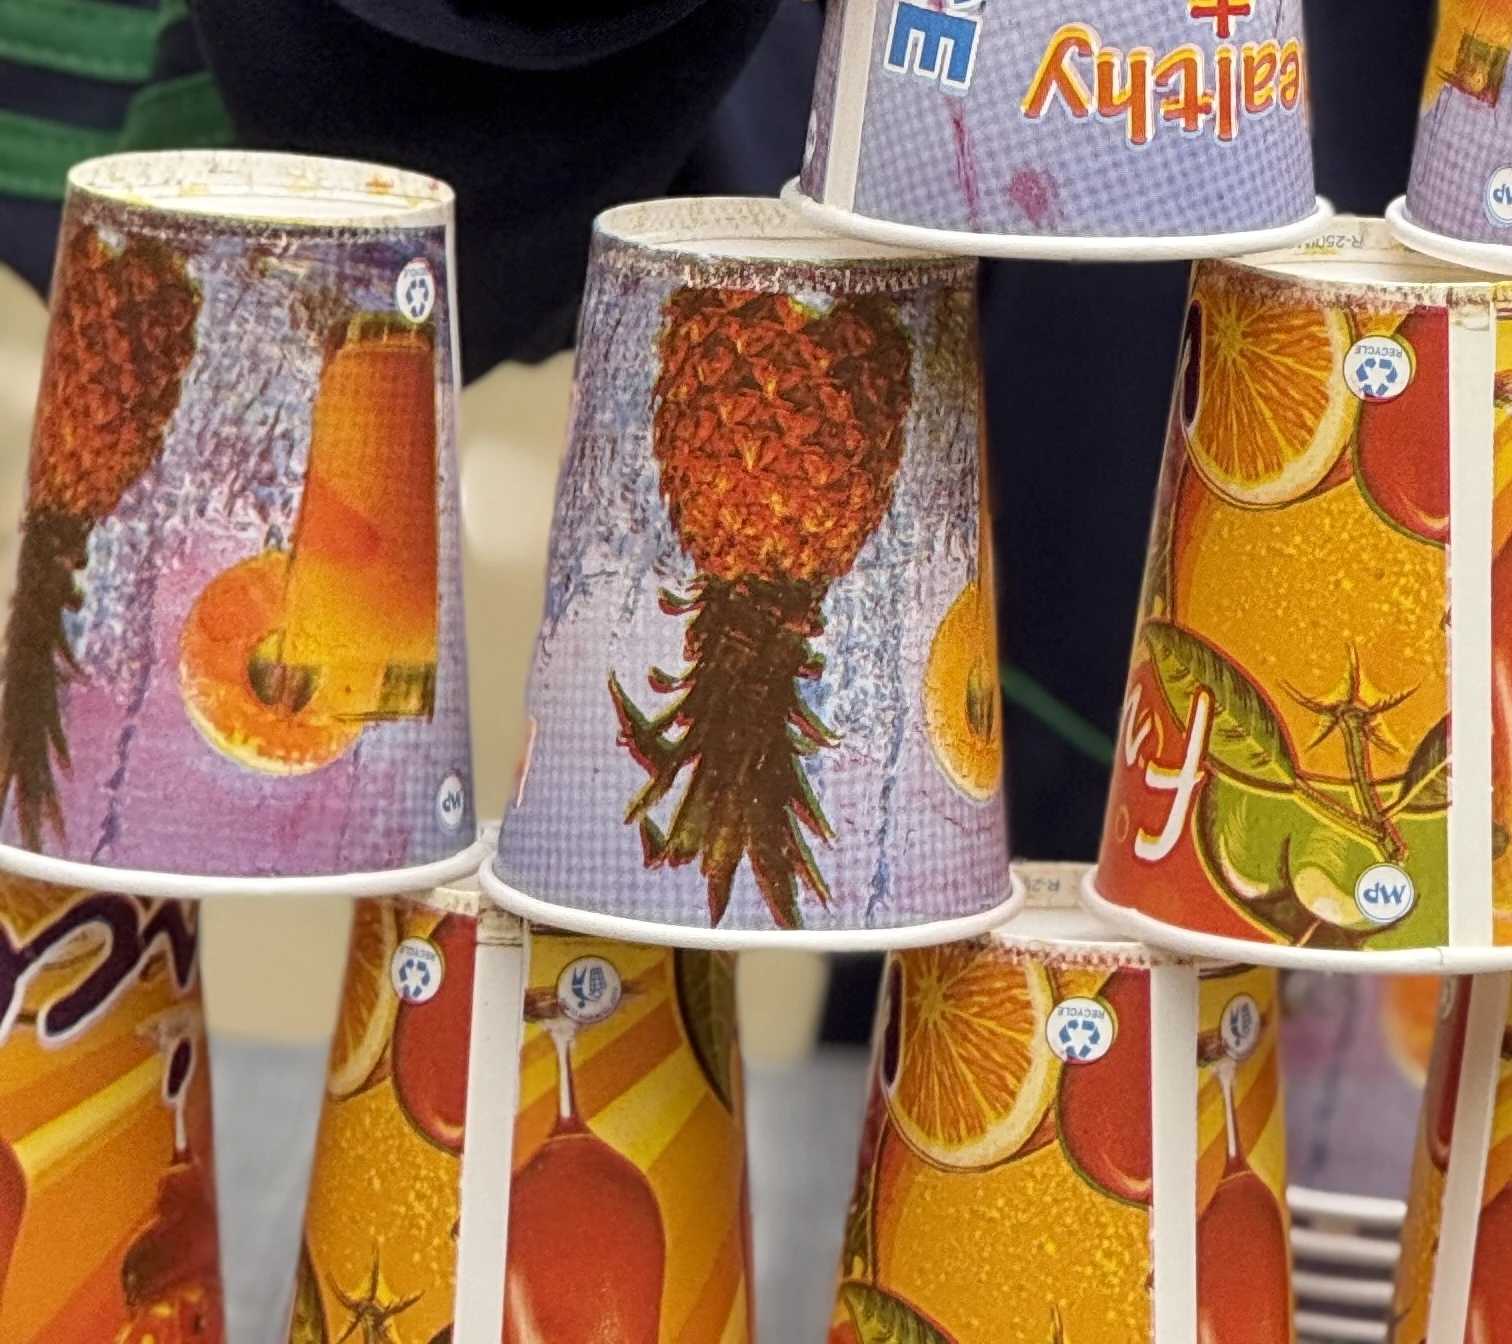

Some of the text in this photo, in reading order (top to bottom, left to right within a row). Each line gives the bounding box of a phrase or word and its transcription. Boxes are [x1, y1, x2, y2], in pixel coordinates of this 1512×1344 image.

[1022, 26, 1306, 142] ealthy
[1354, 345, 1403, 358] RECYCLE
[1363, 881, 1406, 905] MP
[1057, 1006, 1105, 1019] RECYCLE
